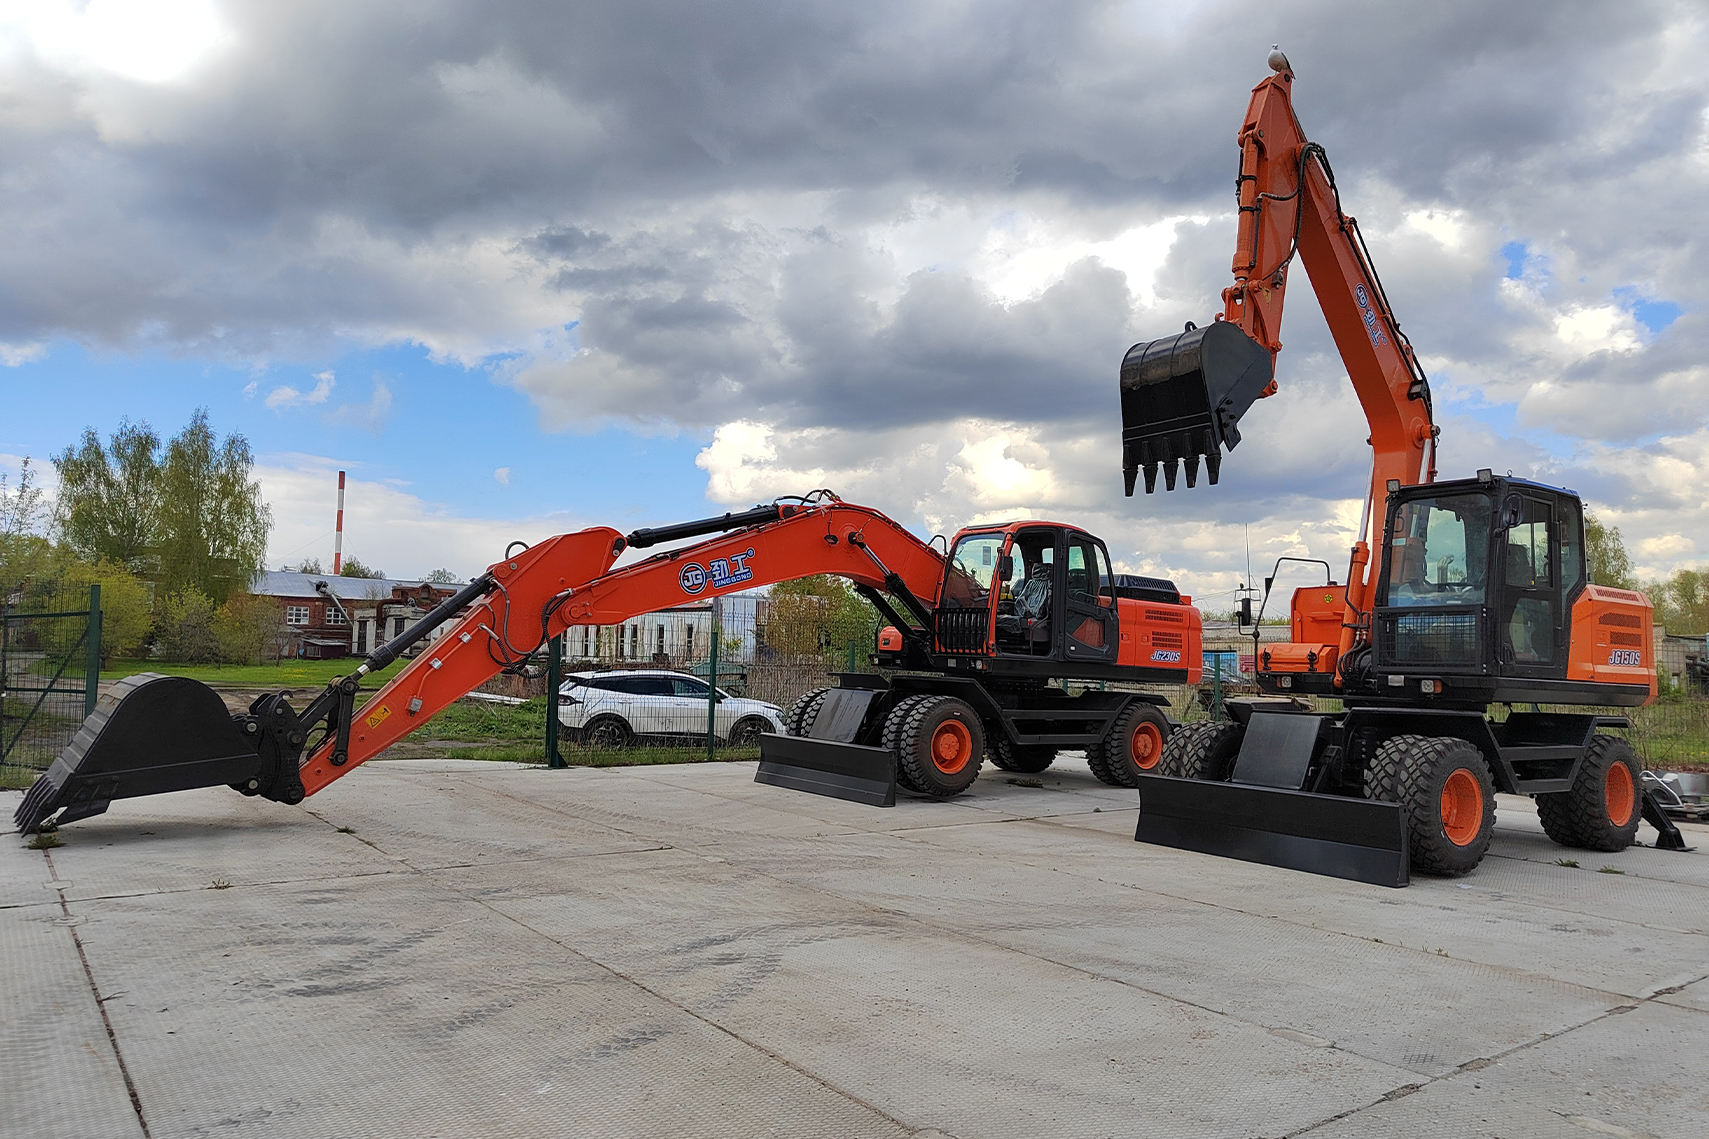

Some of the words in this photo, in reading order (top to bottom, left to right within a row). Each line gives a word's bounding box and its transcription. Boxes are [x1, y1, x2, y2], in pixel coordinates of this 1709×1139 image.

[710, 554, 750, 581] 劲工
[684, 570, 703, 587] JG
[1150, 649, 1181, 662] JG230S
[1609, 649, 1641, 666] JG150S
